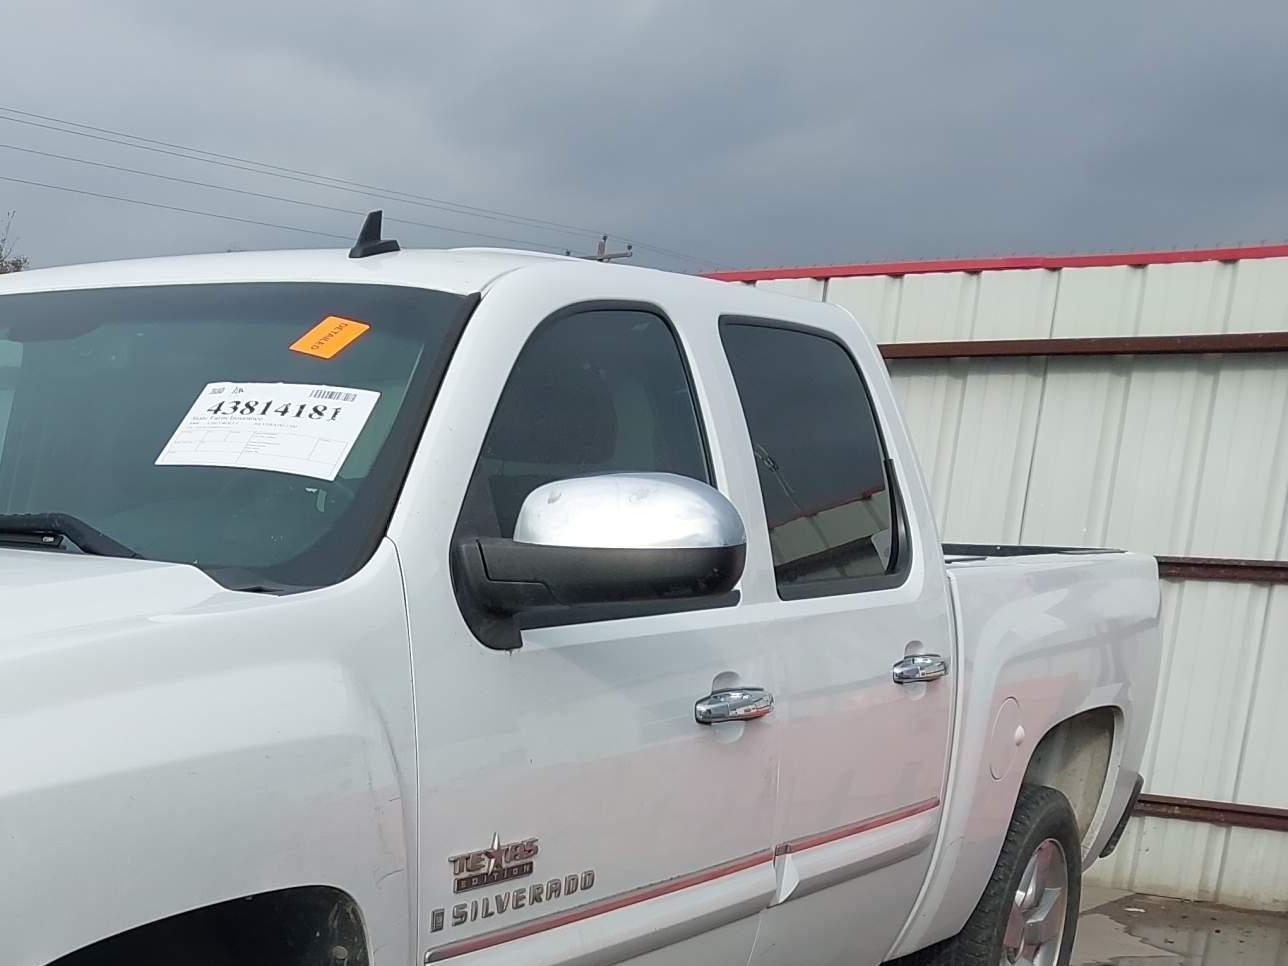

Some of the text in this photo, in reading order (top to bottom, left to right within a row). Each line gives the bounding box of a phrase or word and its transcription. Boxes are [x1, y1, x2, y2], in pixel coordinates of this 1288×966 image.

[206, 399, 342, 422] 43814181
[448, 834, 539, 875] TEXAS
[458, 863, 532, 889] EDITION
[451, 869, 595, 927] SILVERADO
